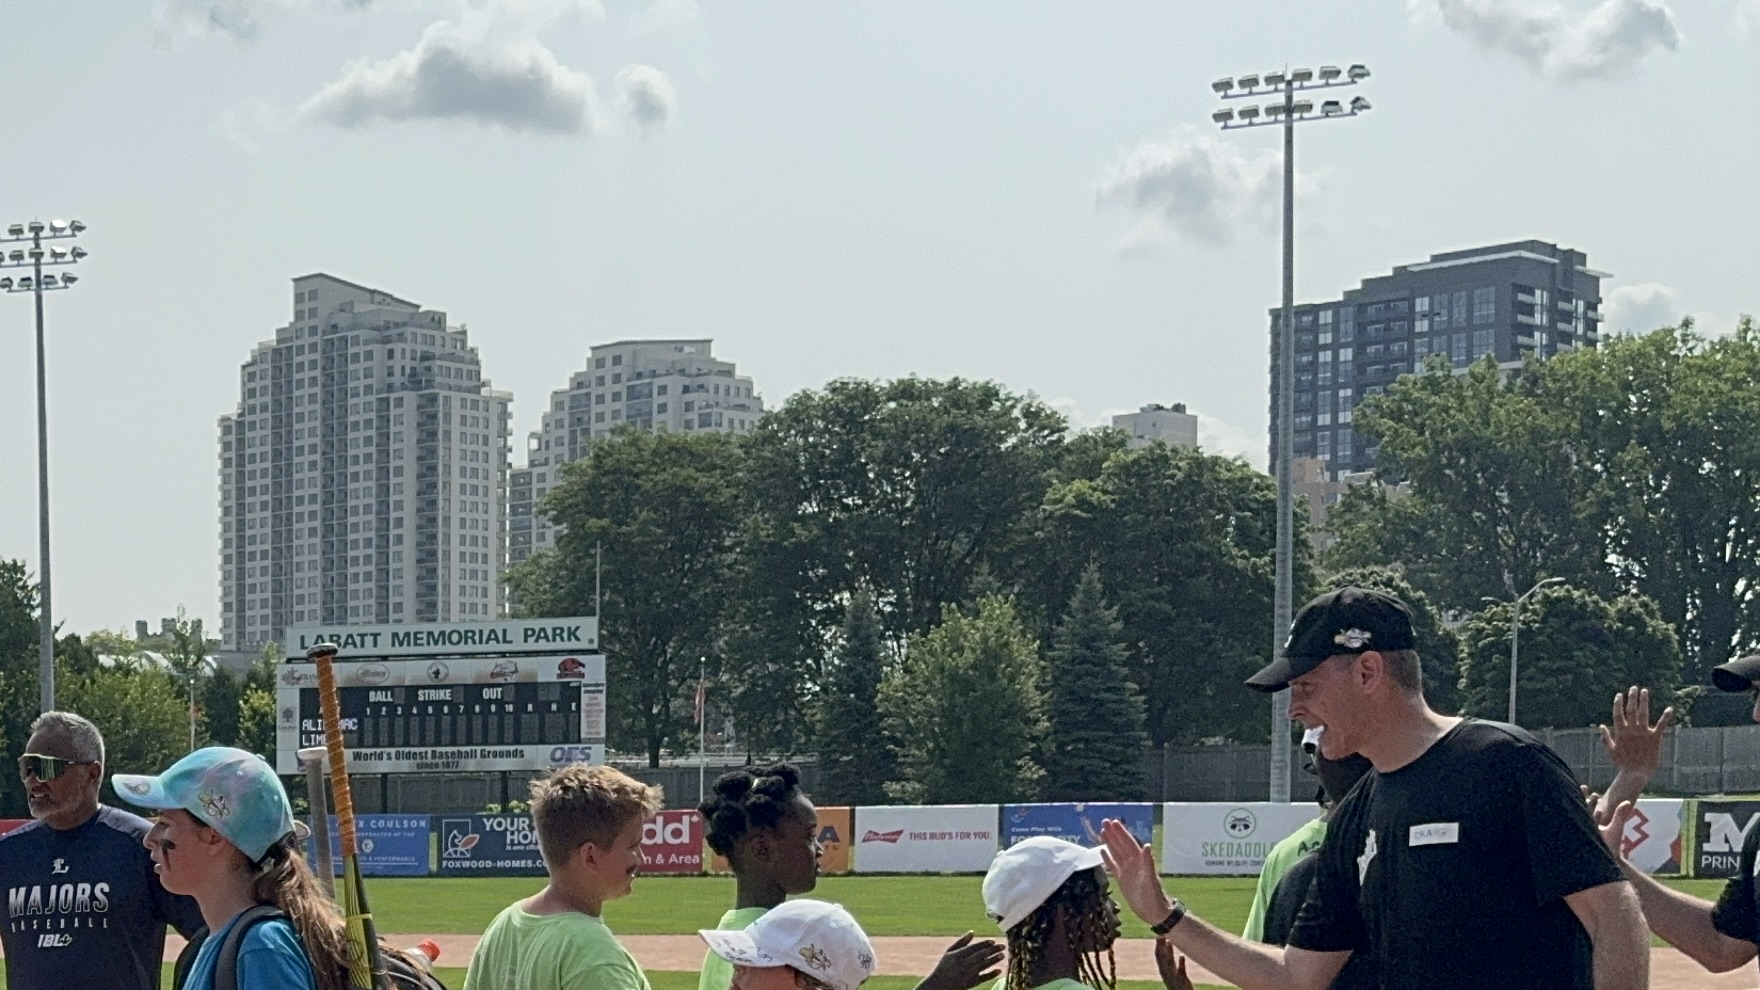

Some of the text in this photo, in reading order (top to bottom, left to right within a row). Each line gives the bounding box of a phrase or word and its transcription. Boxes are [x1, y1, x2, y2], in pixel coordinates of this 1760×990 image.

[300, 626, 581, 650] LABATT MEMORIAL PARK
[368, 690, 393, 702] BALL
[417, 688, 452, 702] STRIKE
[482, 687, 503, 700] OUT
[352, 748, 525, 761] World's Oldest Baseball Grounds
[416, 762, 439, 770] since
[370, 819, 426, 828] COULSON
[482, 817, 530, 831] YOUR
[640, 814, 690, 845] dd
[909, 832, 927, 840] THIS
[929, 831, 953, 840] BUD'S
[955, 831, 971, 840] FOR
[442, 860, 548, 868] FOXWOOD-HOMES.CO
[655, 853, 665, 864] &
[668, 853, 700, 864] Area
[1701, 856, 1740, 870] PRIN
[9, 883, 110, 918] MAJORS
[11, 918, 108, 933] BASEBALL
[37, 933, 63, 948] IBL
